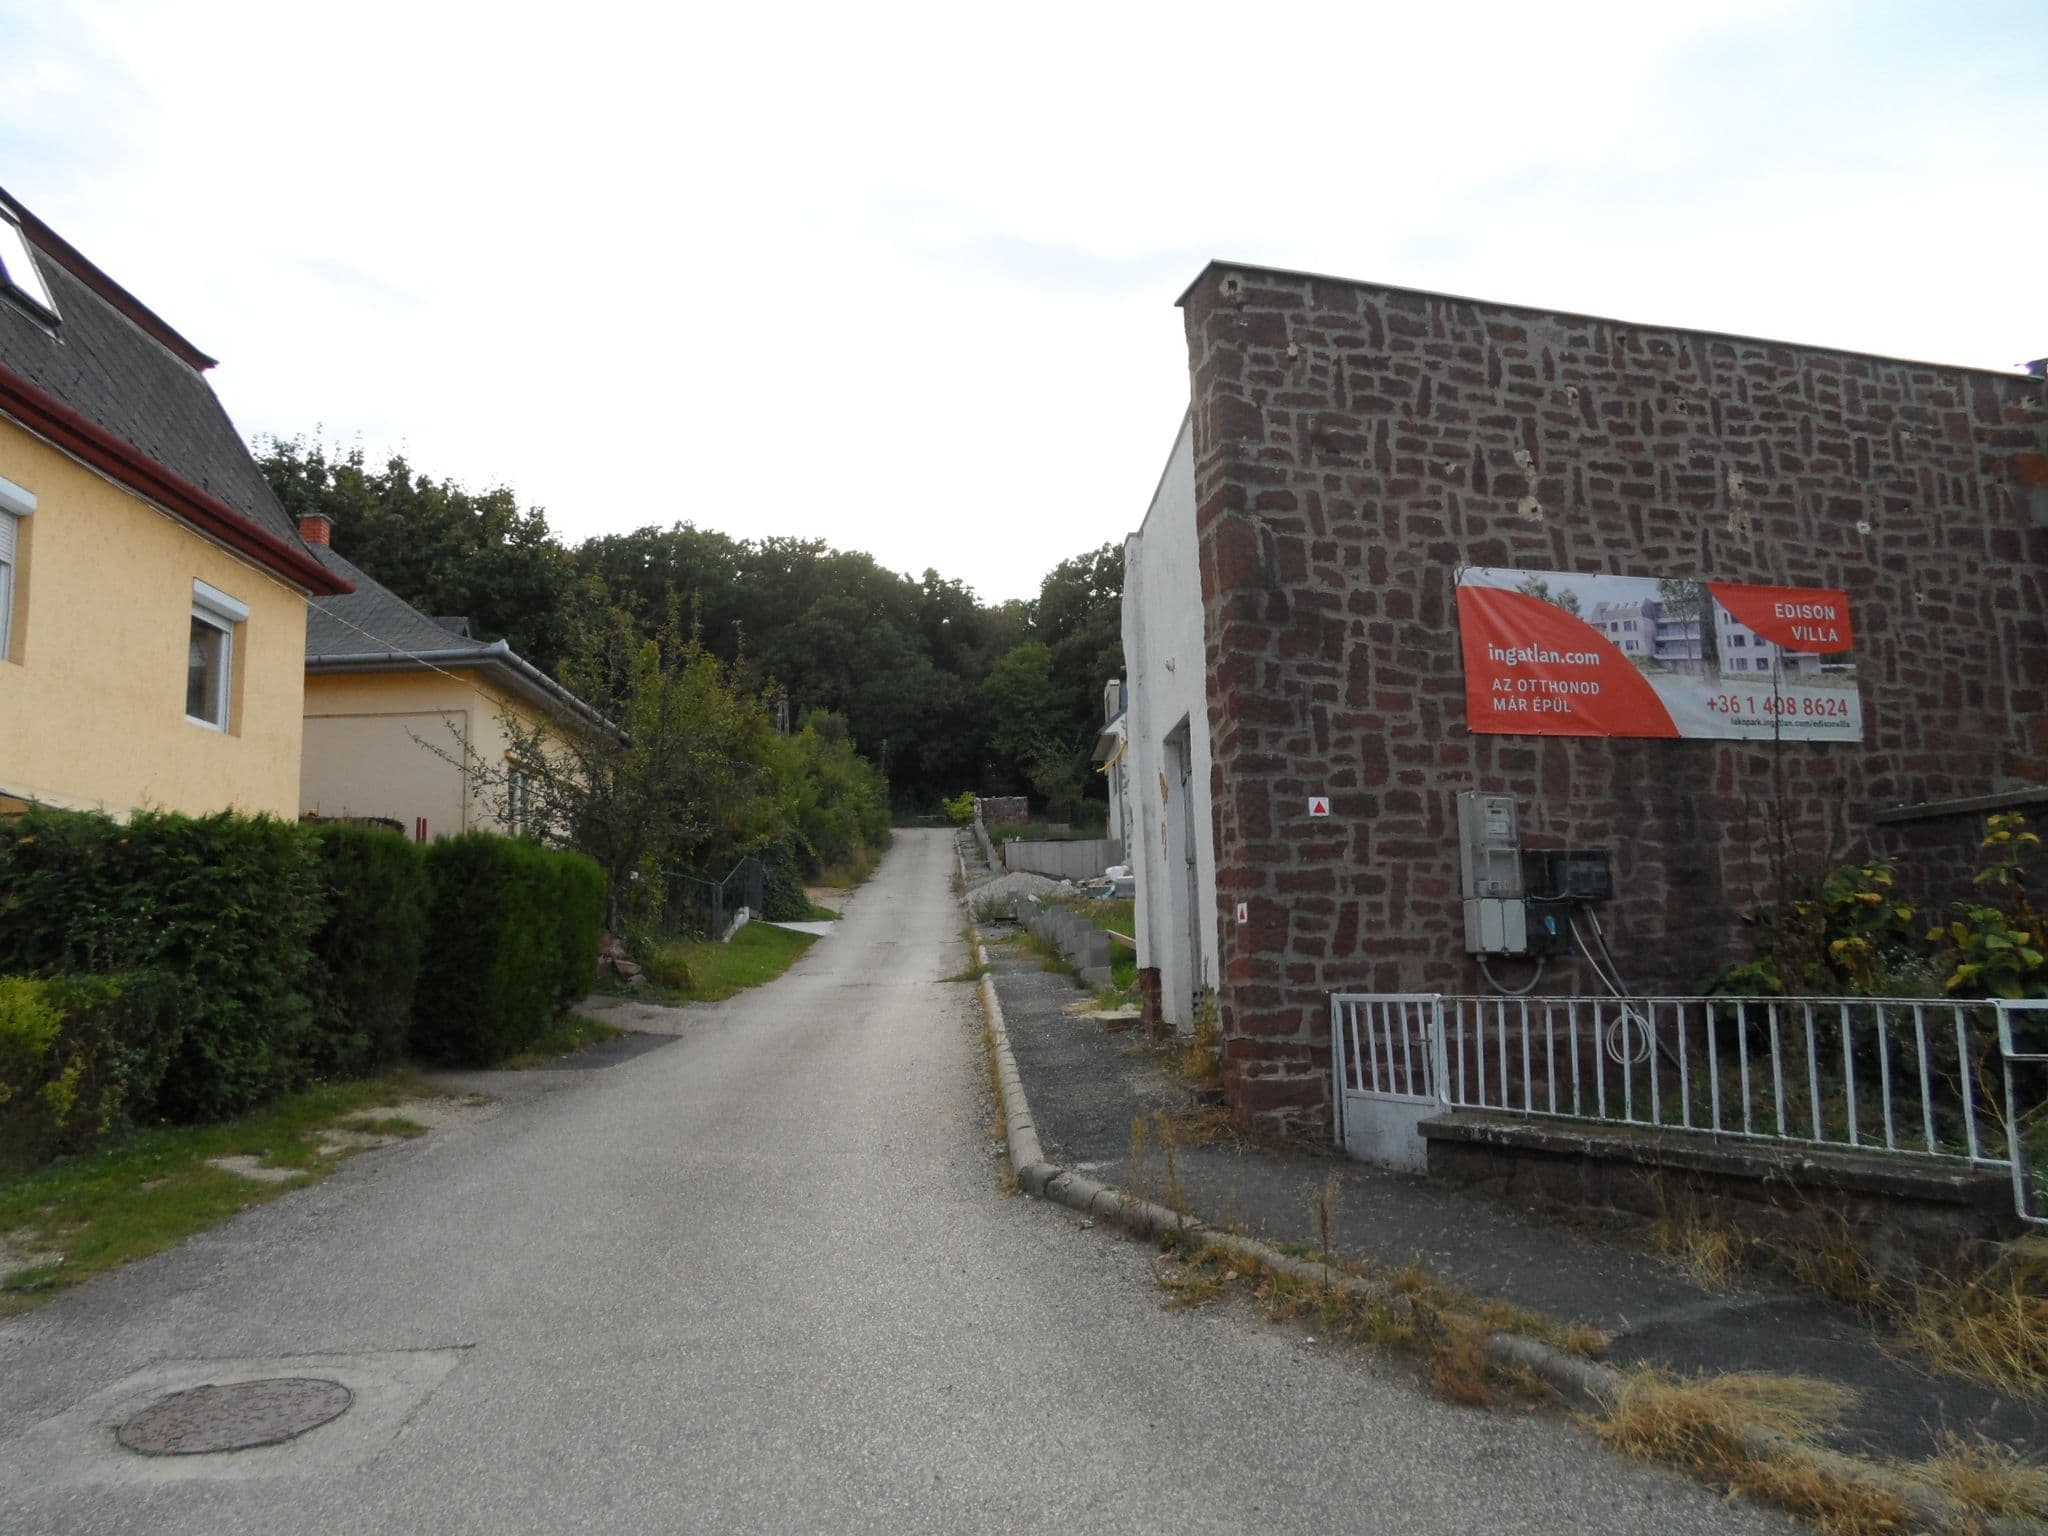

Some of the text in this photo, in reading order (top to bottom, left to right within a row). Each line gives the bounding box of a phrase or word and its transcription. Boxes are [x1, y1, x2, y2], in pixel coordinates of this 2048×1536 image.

[1774, 603, 1836, 620] EDISON
[1791, 626, 1839, 642] VILLA
[1488, 643, 1600, 665] ingatlan.com
[1492, 678, 1600, 695] AZ OTTHONOD
[1493, 695, 1572, 714] MÁR ÉPÜL
[1707, 694, 1849, 717] +36 1 408 8624
